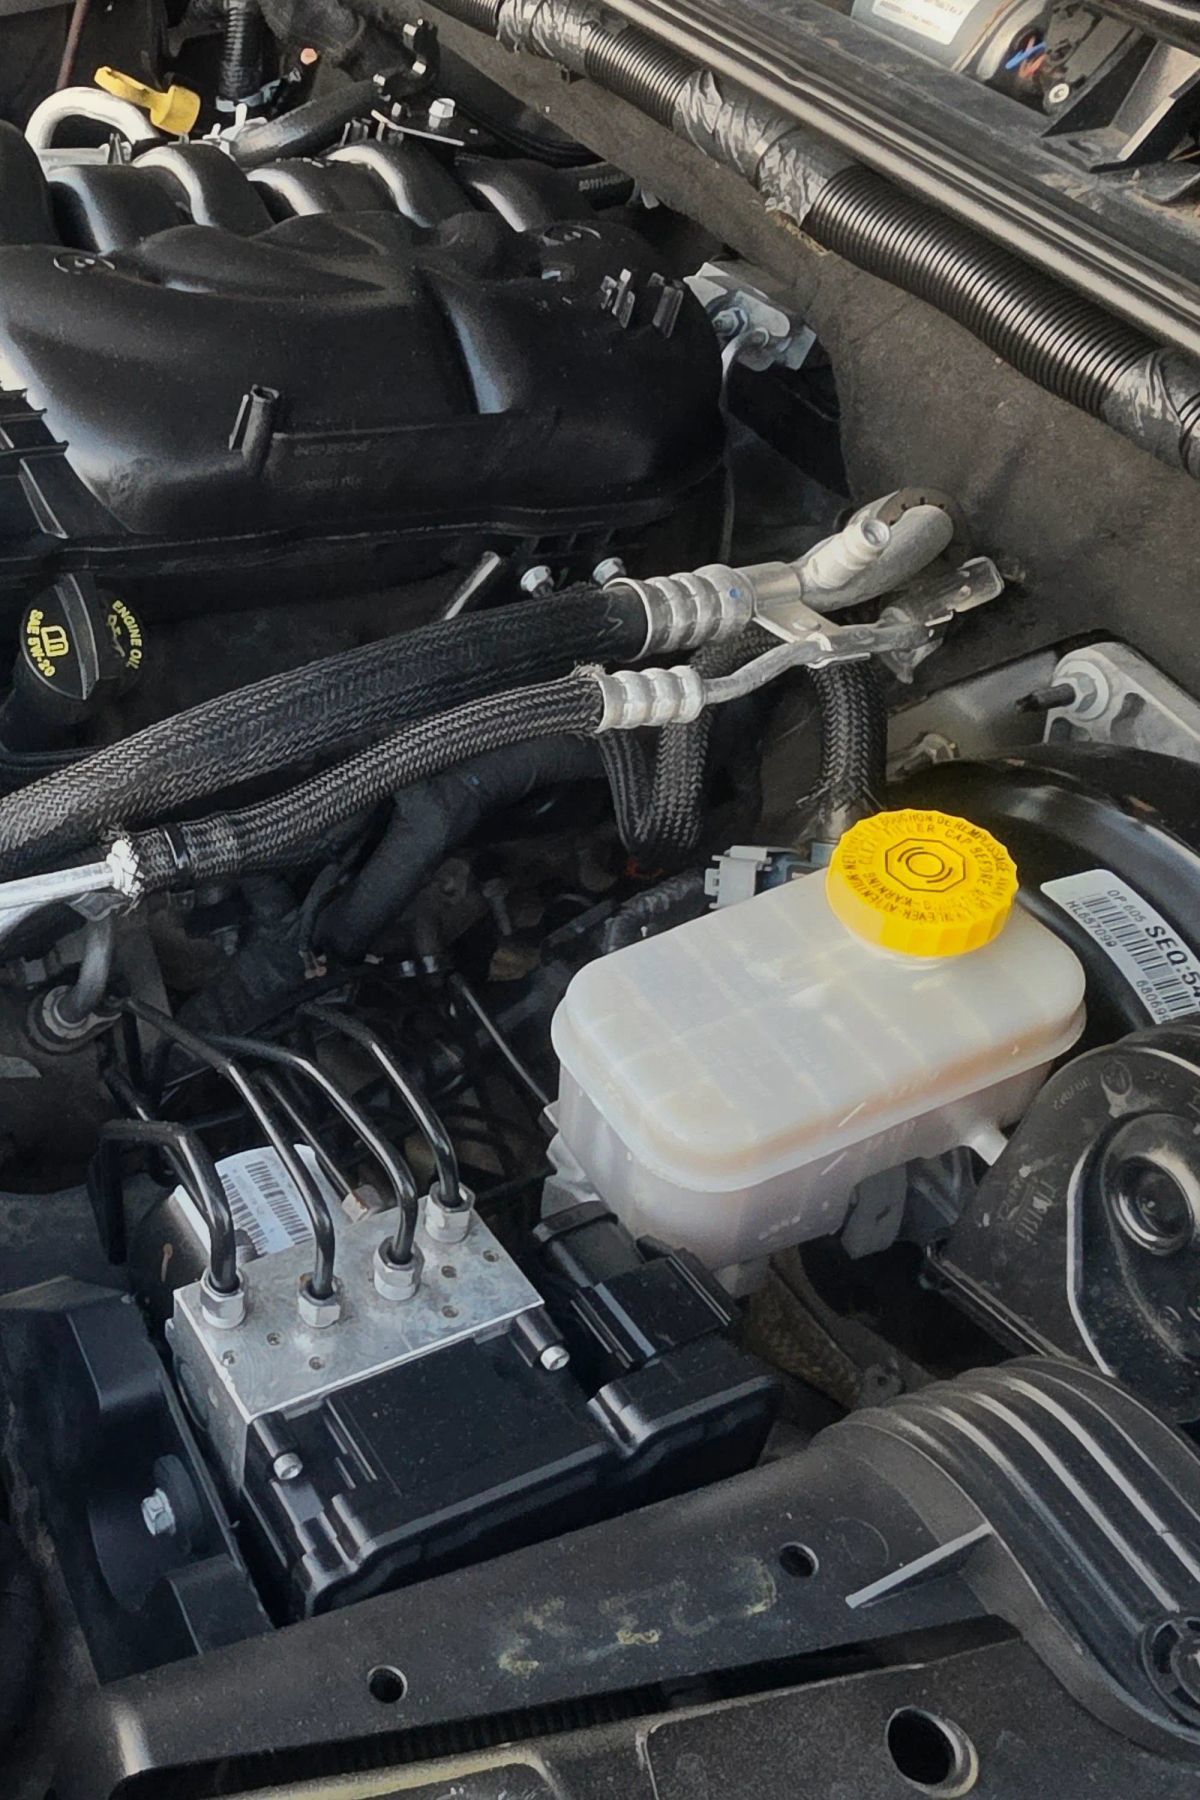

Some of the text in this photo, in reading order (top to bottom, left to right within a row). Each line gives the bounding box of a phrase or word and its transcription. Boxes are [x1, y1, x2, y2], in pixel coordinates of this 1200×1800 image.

[26, 609, 56, 677] SAE 5W-20
[112, 600, 143, 669] ENGINE OIL
[944, 828, 973, 846] CAP
